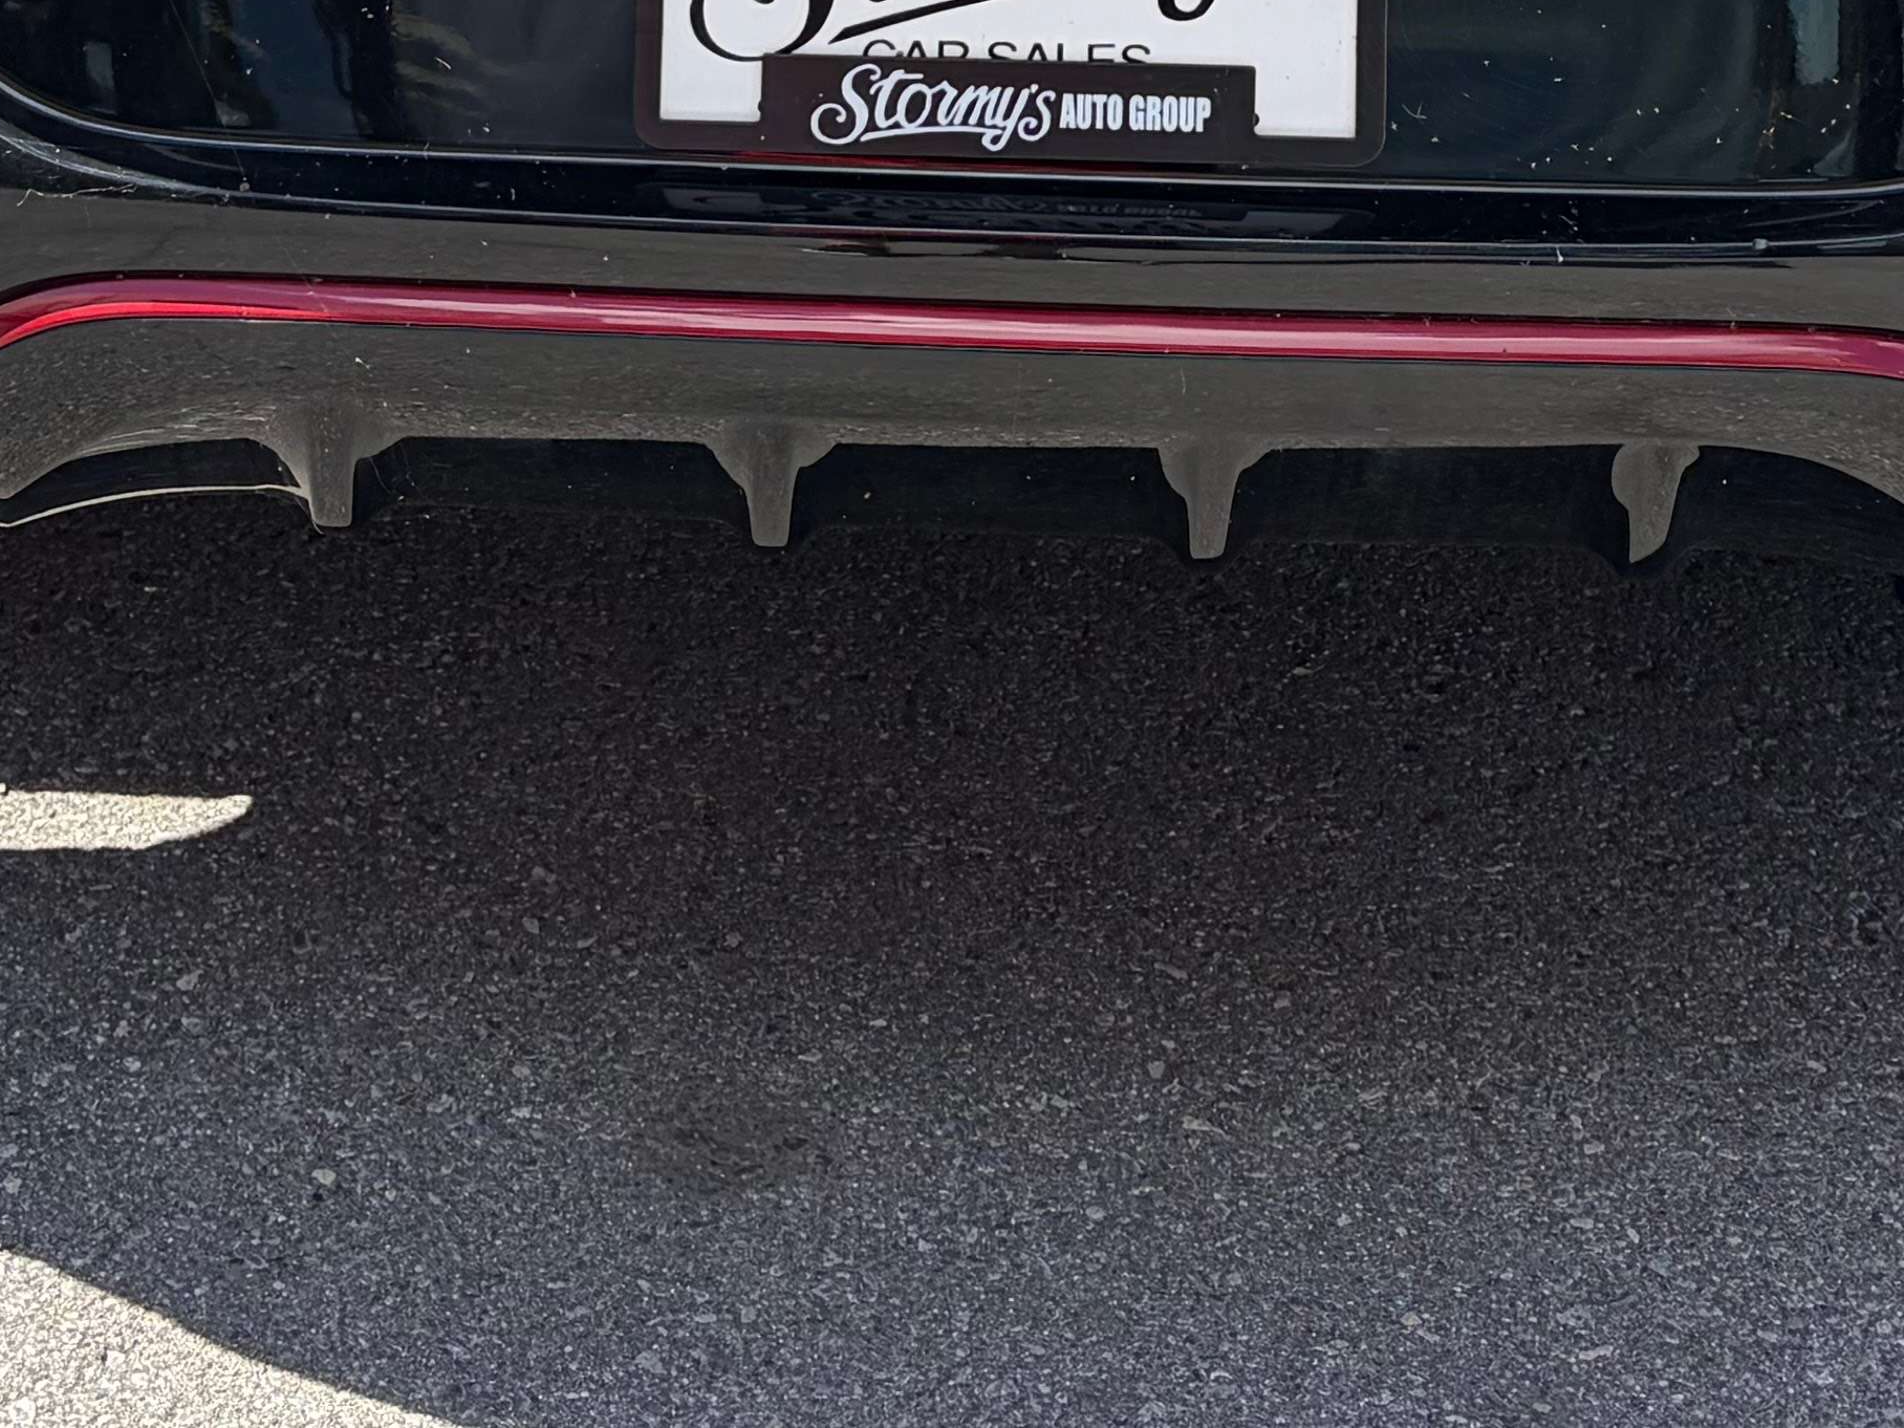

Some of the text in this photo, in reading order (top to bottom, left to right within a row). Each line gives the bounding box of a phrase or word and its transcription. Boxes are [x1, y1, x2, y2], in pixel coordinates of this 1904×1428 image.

[810, 64, 1212, 152] Stormy's AUTO GROUP
